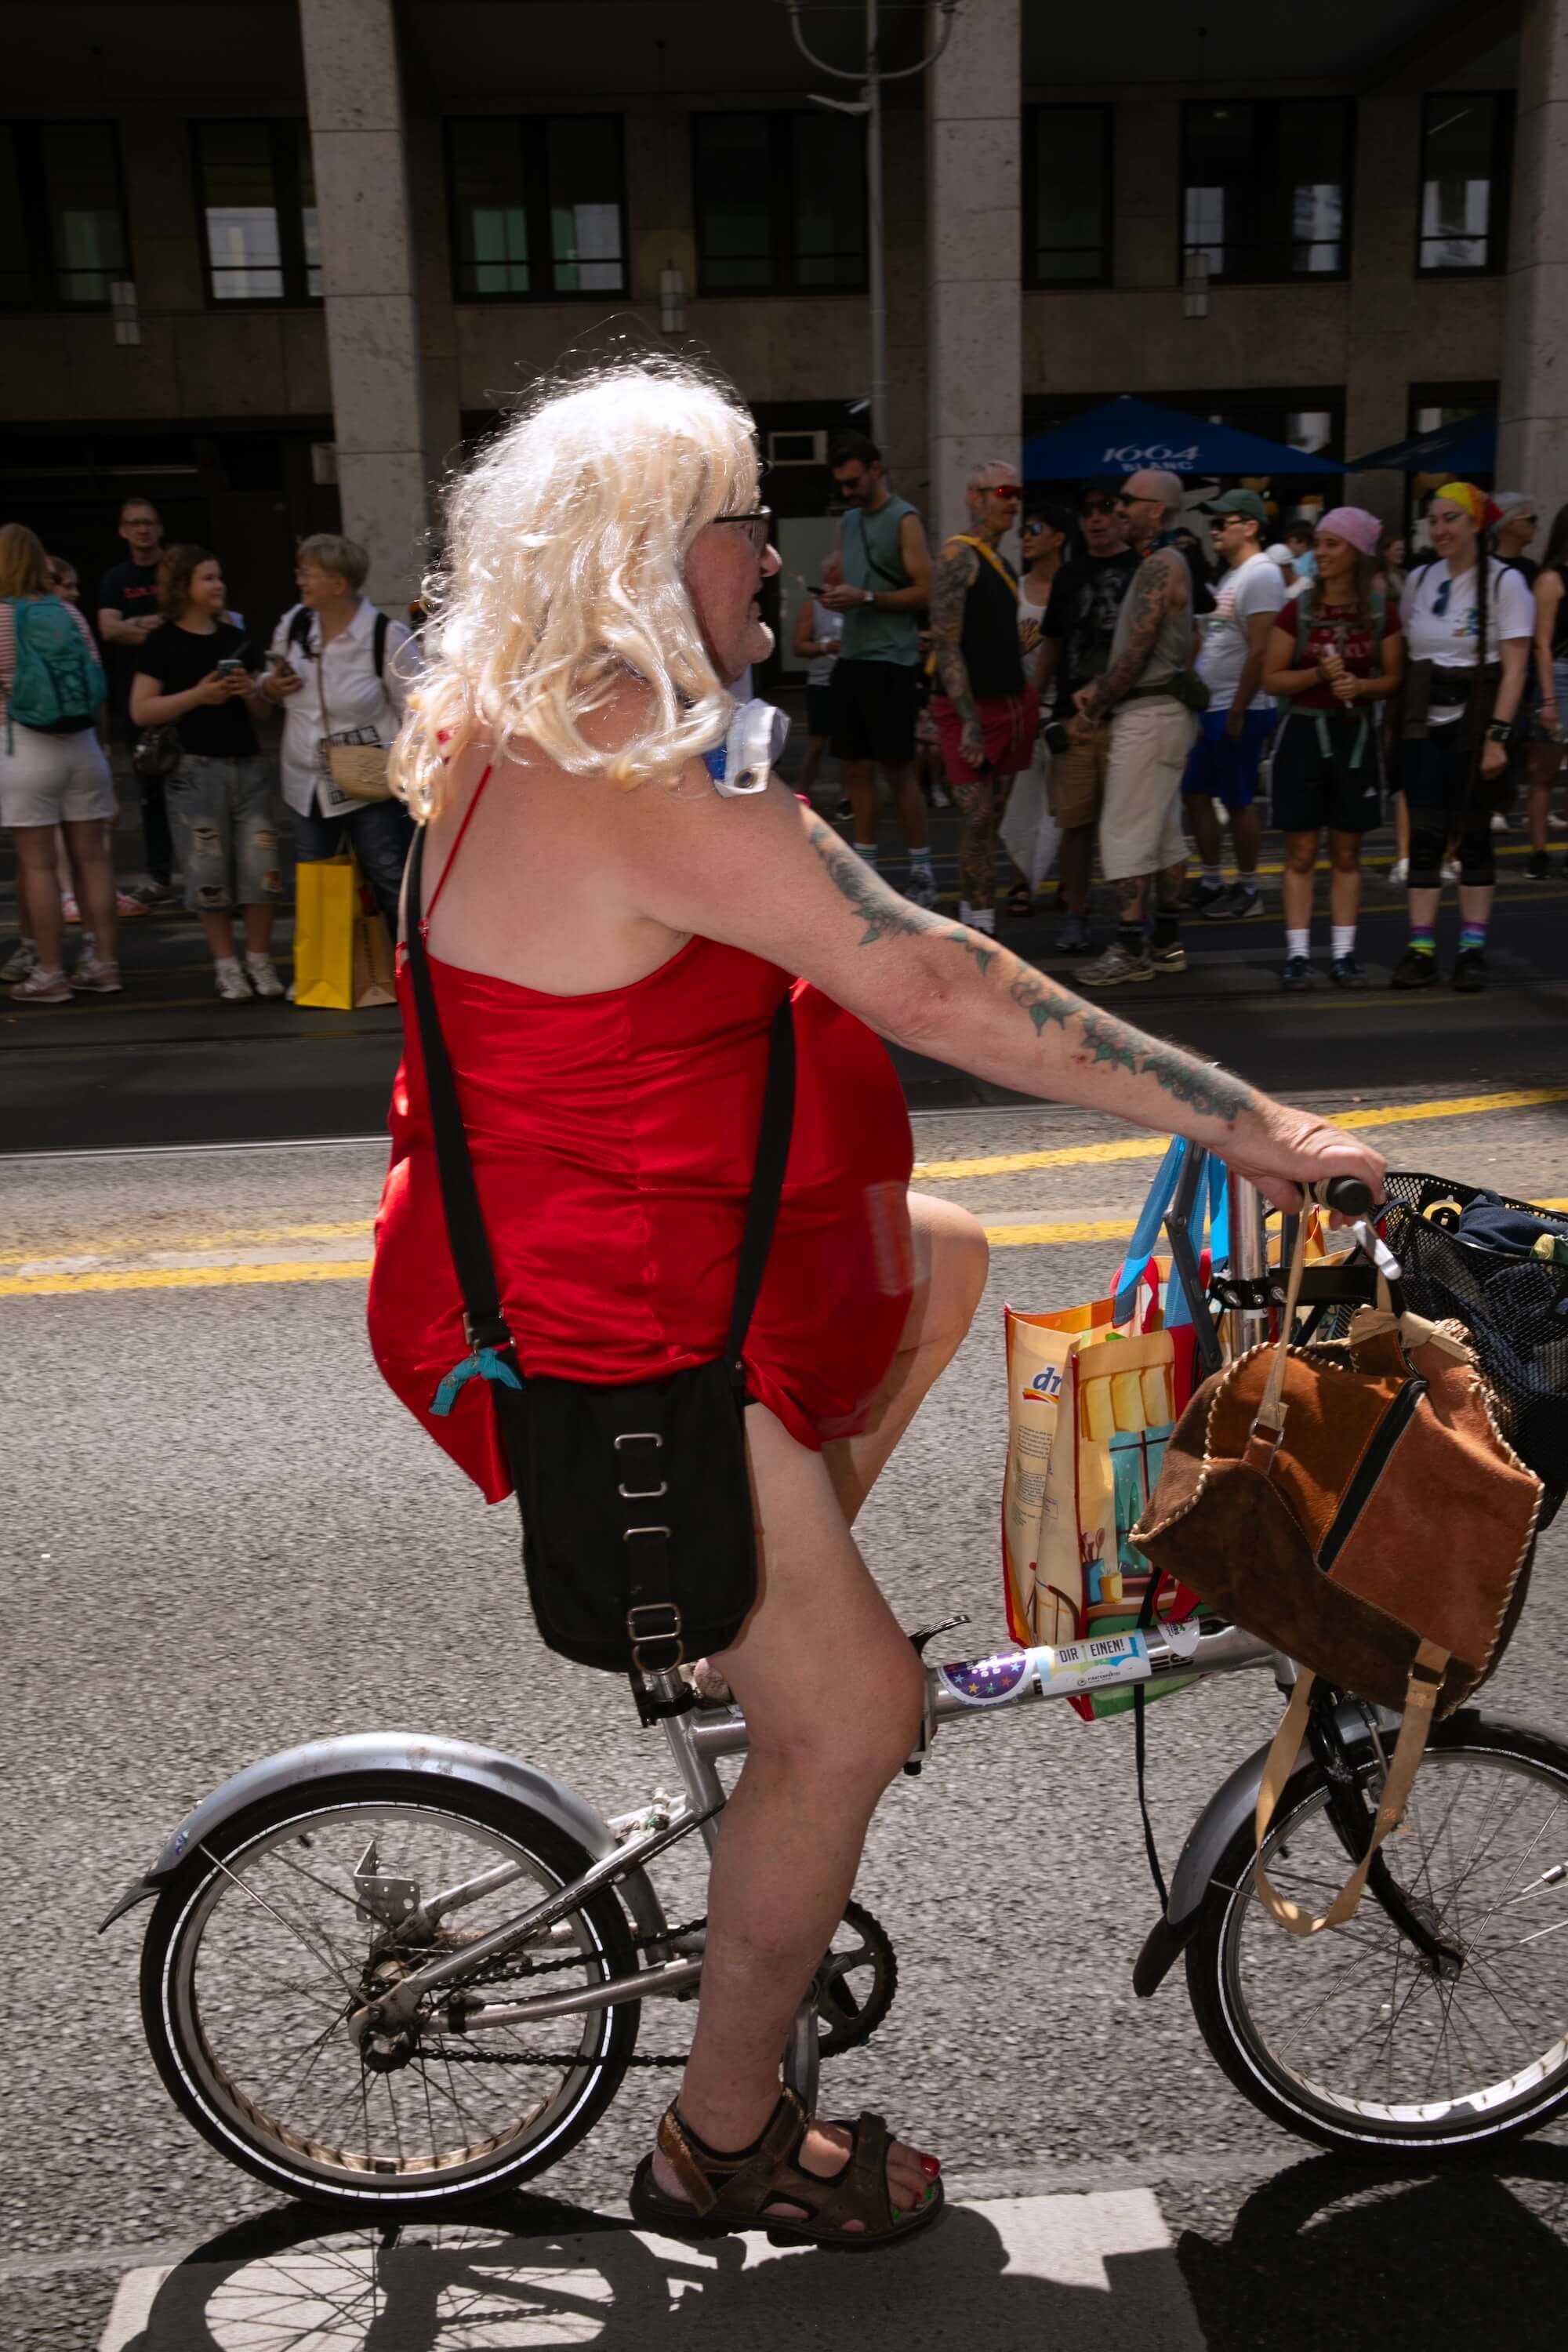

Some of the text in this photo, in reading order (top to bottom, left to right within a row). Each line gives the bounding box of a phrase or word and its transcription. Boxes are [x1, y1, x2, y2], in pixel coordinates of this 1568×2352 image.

[1102, 443, 1203, 463] 1664
[1120, 461, 1194, 472] BLANC
[1059, 1638, 1125, 1663] DIR EINEN!
